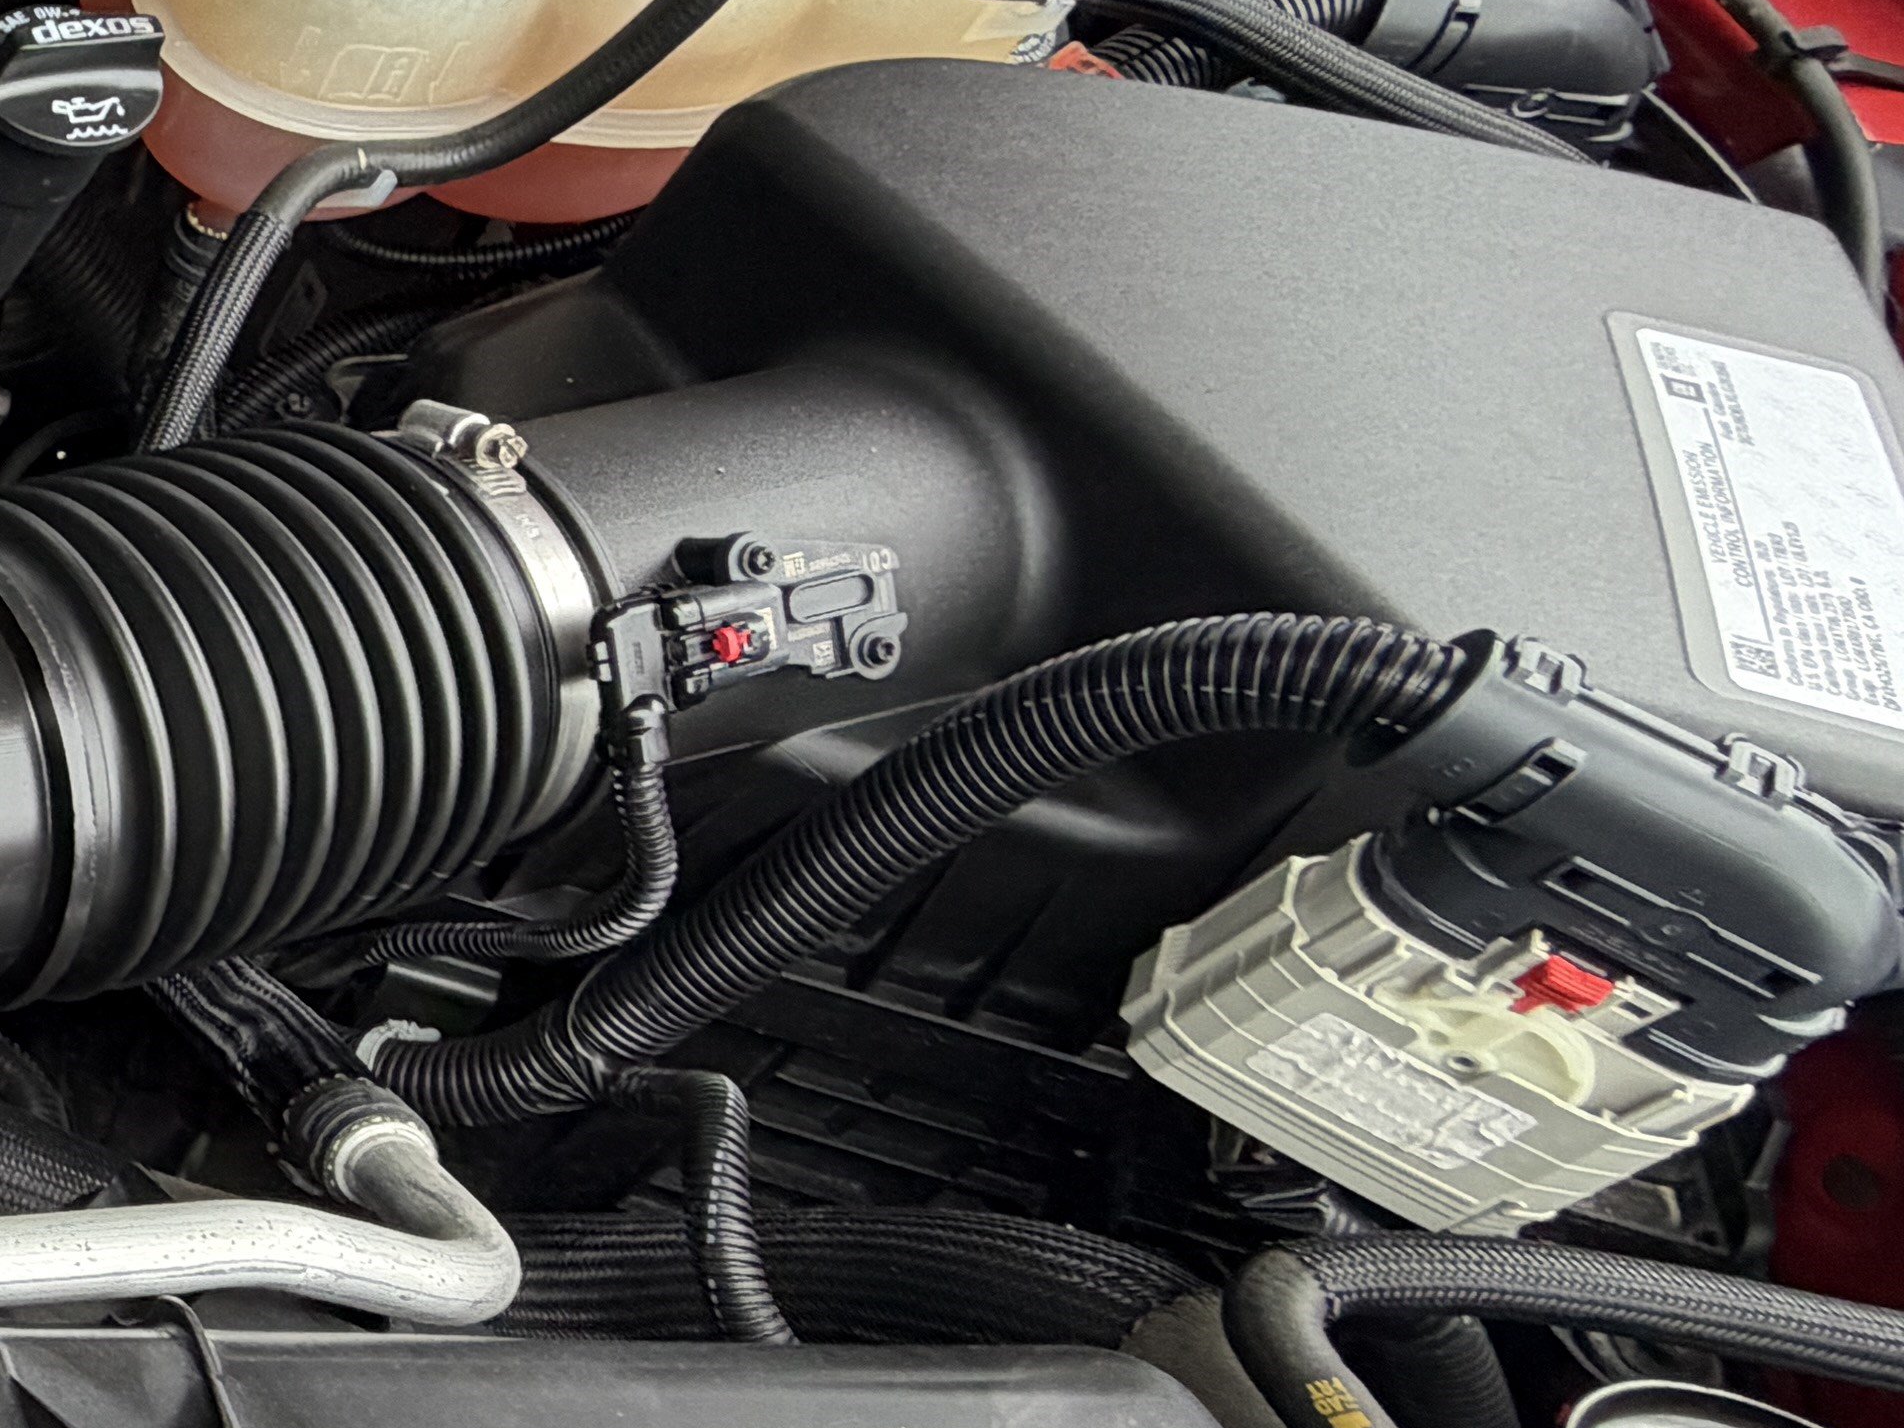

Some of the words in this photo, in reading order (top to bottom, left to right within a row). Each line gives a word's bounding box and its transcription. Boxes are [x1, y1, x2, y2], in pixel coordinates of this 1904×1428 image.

[31, 16, 154, 44] dexos
[1683, 450, 1714, 508] EMISSION
[1699, 511, 1727, 563] VEHICLE
[1723, 529, 1753, 587] CONTROL
